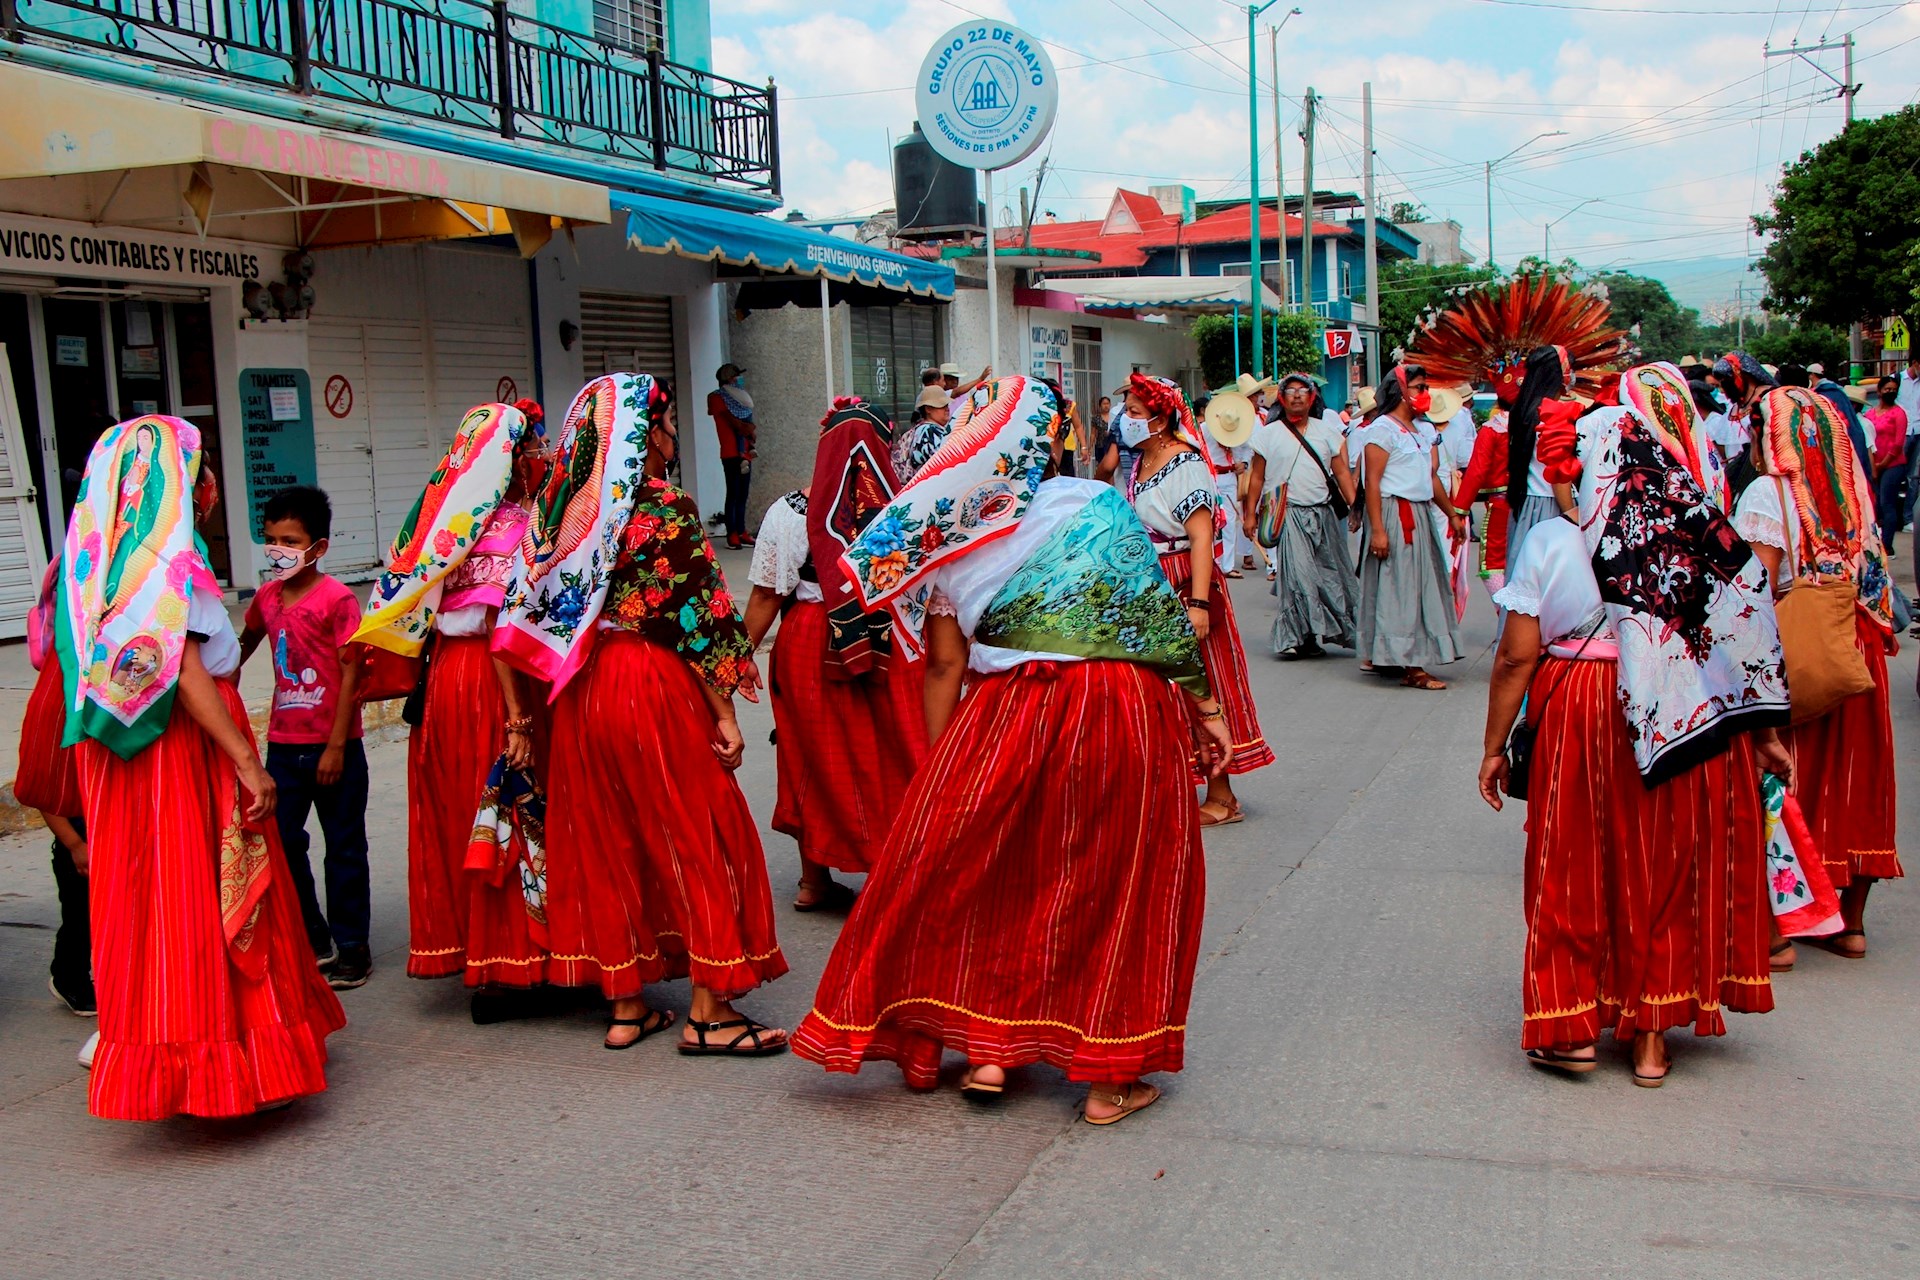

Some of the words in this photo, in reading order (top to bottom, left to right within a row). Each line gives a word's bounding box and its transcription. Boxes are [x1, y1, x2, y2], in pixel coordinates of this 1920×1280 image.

[929, 38, 964, 95] GRUPO
[967, 28, 987, 43] 22
[992, 28, 1014, 44] DE
[1015, 40, 1043, 86] MAYO
[935, 113, 970, 150] SESIONES
[988, 143, 994, 151] 8
[996, 139, 1010, 150] PM
[1012, 134, 1019, 142] A
[1019, 124, 1029, 134] 10
[1028, 106, 1038, 122] PM
[211, 118, 449, 195] CARNICERIA
[0, 229, 65, 261] VICIOS
[70, 236, 170, 271] CONTABLES
[174, 247, 184, 272] Y
[190, 248, 259, 278] FISCALES
[807, 244, 871, 271] BIENVENIDOS
[877, 358, 886, 366] NO
[920, 360, 929, 368] NO
[250, 374, 297, 388] TRAMITES
[248, 395, 262, 406] SAT
[248, 410, 266, 420] IMSS
[248, 423, 284, 433] INFONAVIT
[249, 436, 270, 447] AFORE
[250, 450, 265, 460] SUA
[251, 463, 275, 473] SIPARE
